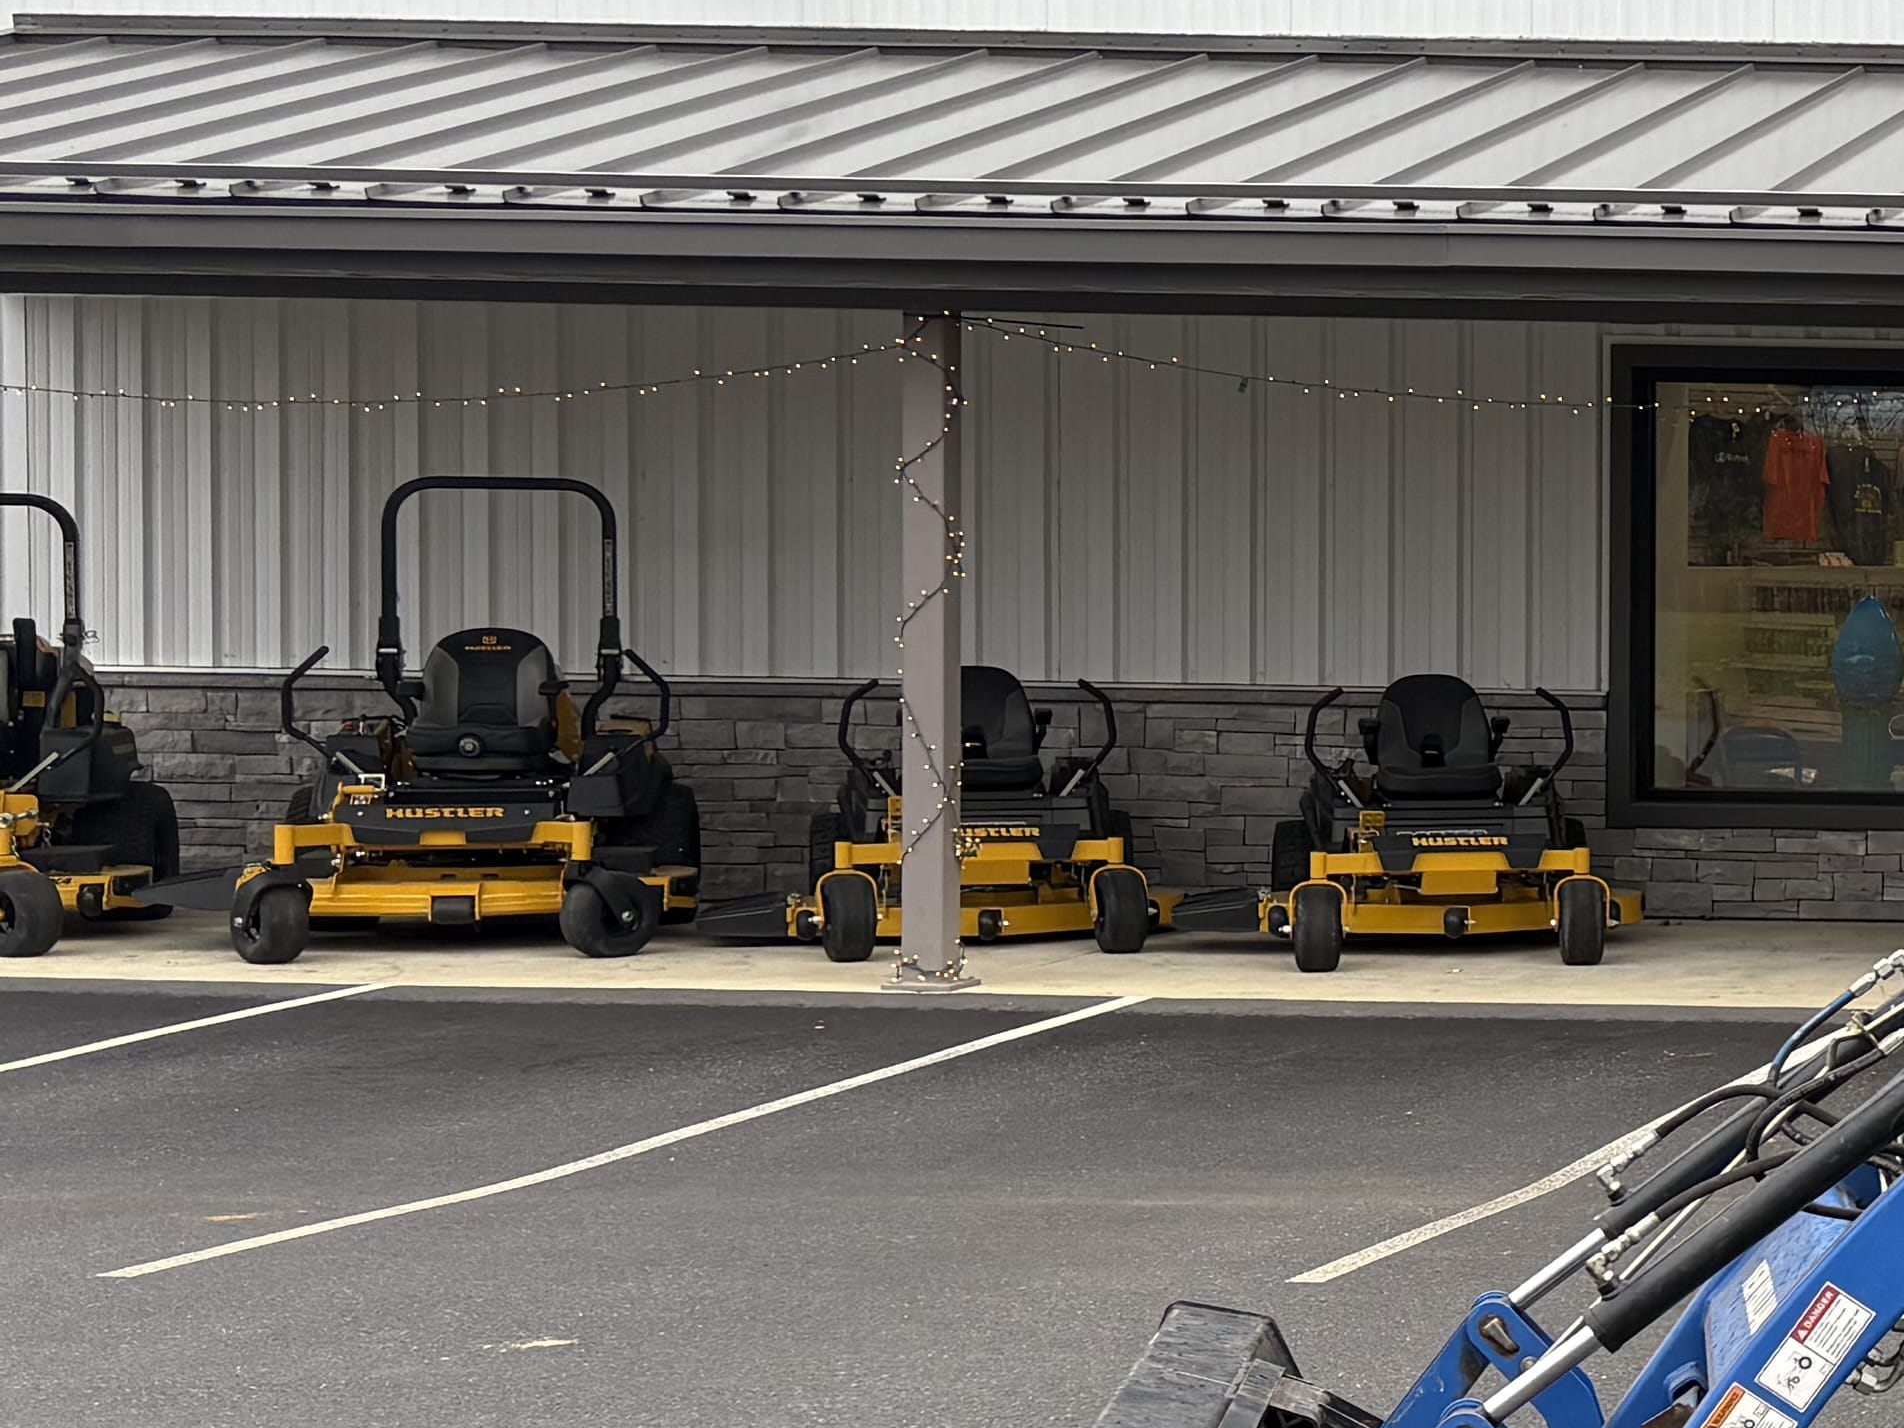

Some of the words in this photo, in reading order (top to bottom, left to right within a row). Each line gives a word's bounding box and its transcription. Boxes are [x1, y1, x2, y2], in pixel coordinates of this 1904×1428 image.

[385, 807, 505, 819] HUSTLER
[959, 827, 1040, 837] USTLER
[1411, 836, 1508, 847] HUSTLER
[1804, 1290, 1835, 1328] DANGER
